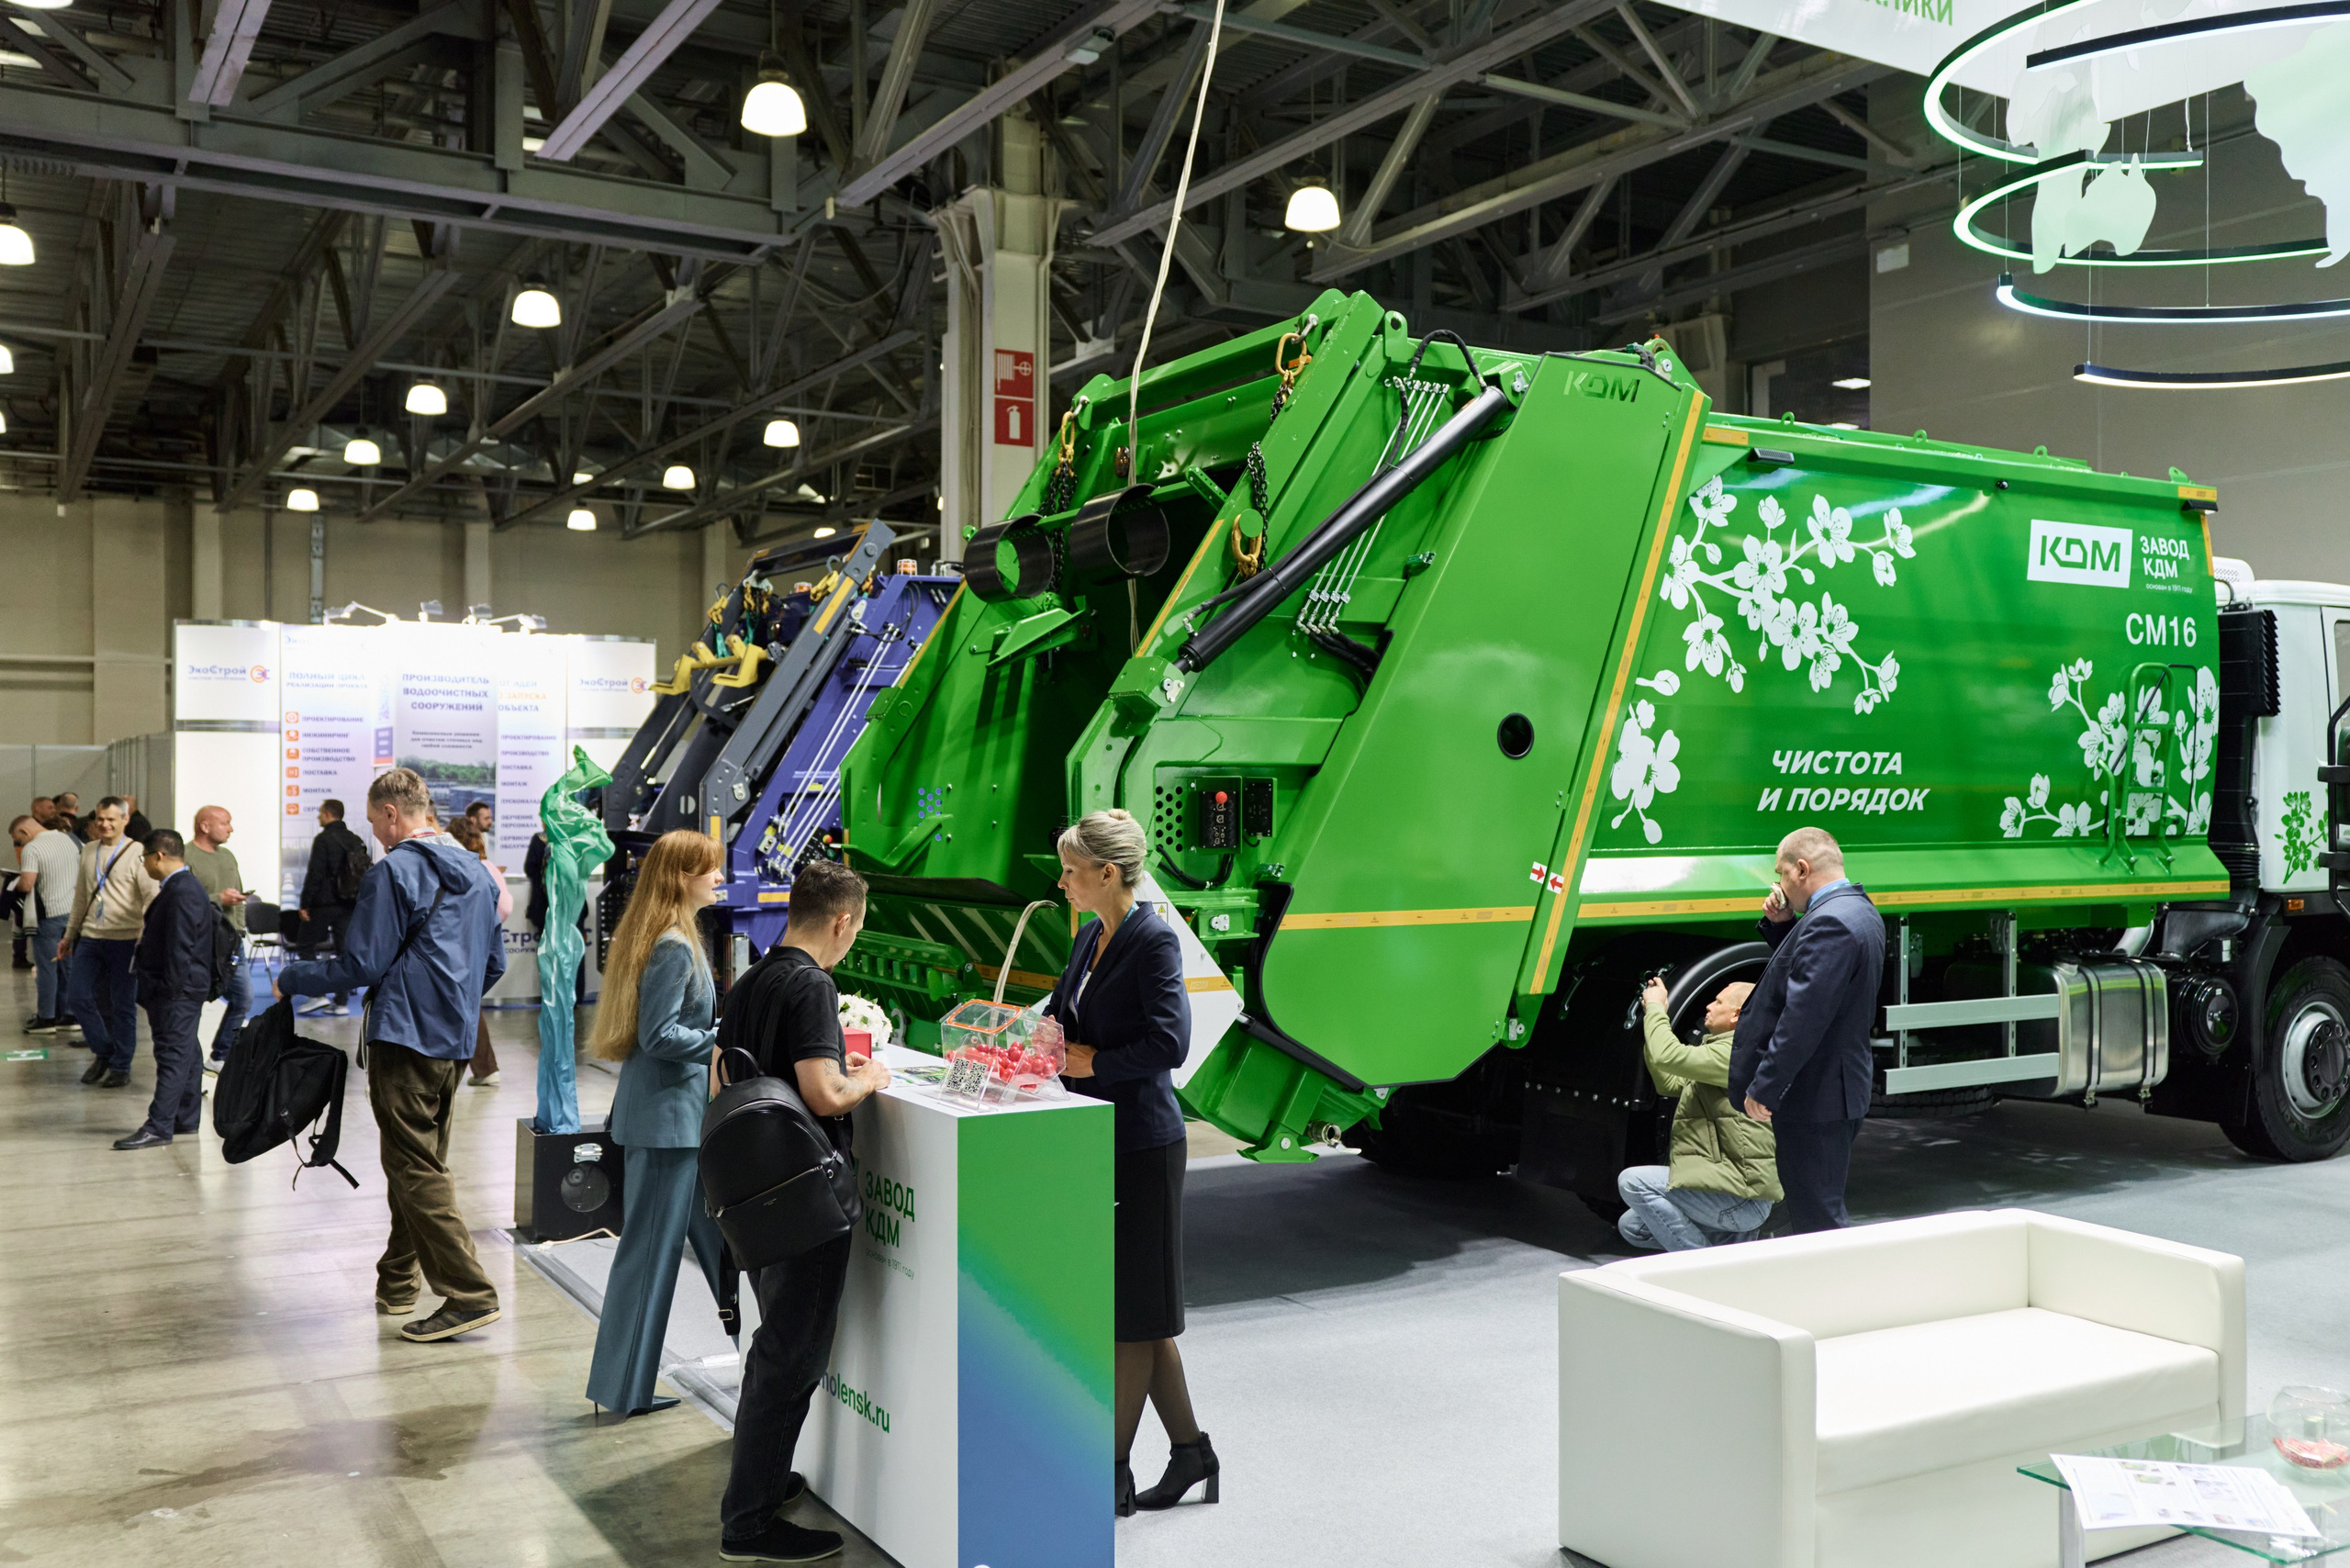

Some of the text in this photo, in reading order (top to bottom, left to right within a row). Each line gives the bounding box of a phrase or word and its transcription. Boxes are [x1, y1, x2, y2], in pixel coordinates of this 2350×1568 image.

[2140, 535, 2190, 560] ЗАВОД
[2143, 557, 2178, 579] КДМ
[188, 665, 246, 677] ЭкоСтрой
[402, 674, 489, 684] ПРОИЗВОДИТЕЛЬ
[403, 688, 488, 698] ВОДООЧИСТНЫХ
[580, 678, 628, 689] ЭкоСтрой
[411, 700, 483, 711] СООРУЖЕНИЙ
[1772, 750, 1903, 775] ЧИСТОТА
[1756, 788, 1931, 815] И ПОРЯДОК
[866, 1170, 915, 1223] ЗАВОД
[866, 1205, 900, 1249] КДМ
[866, 1249, 887, 1263] основан
[902, 1266, 915, 1280] году
